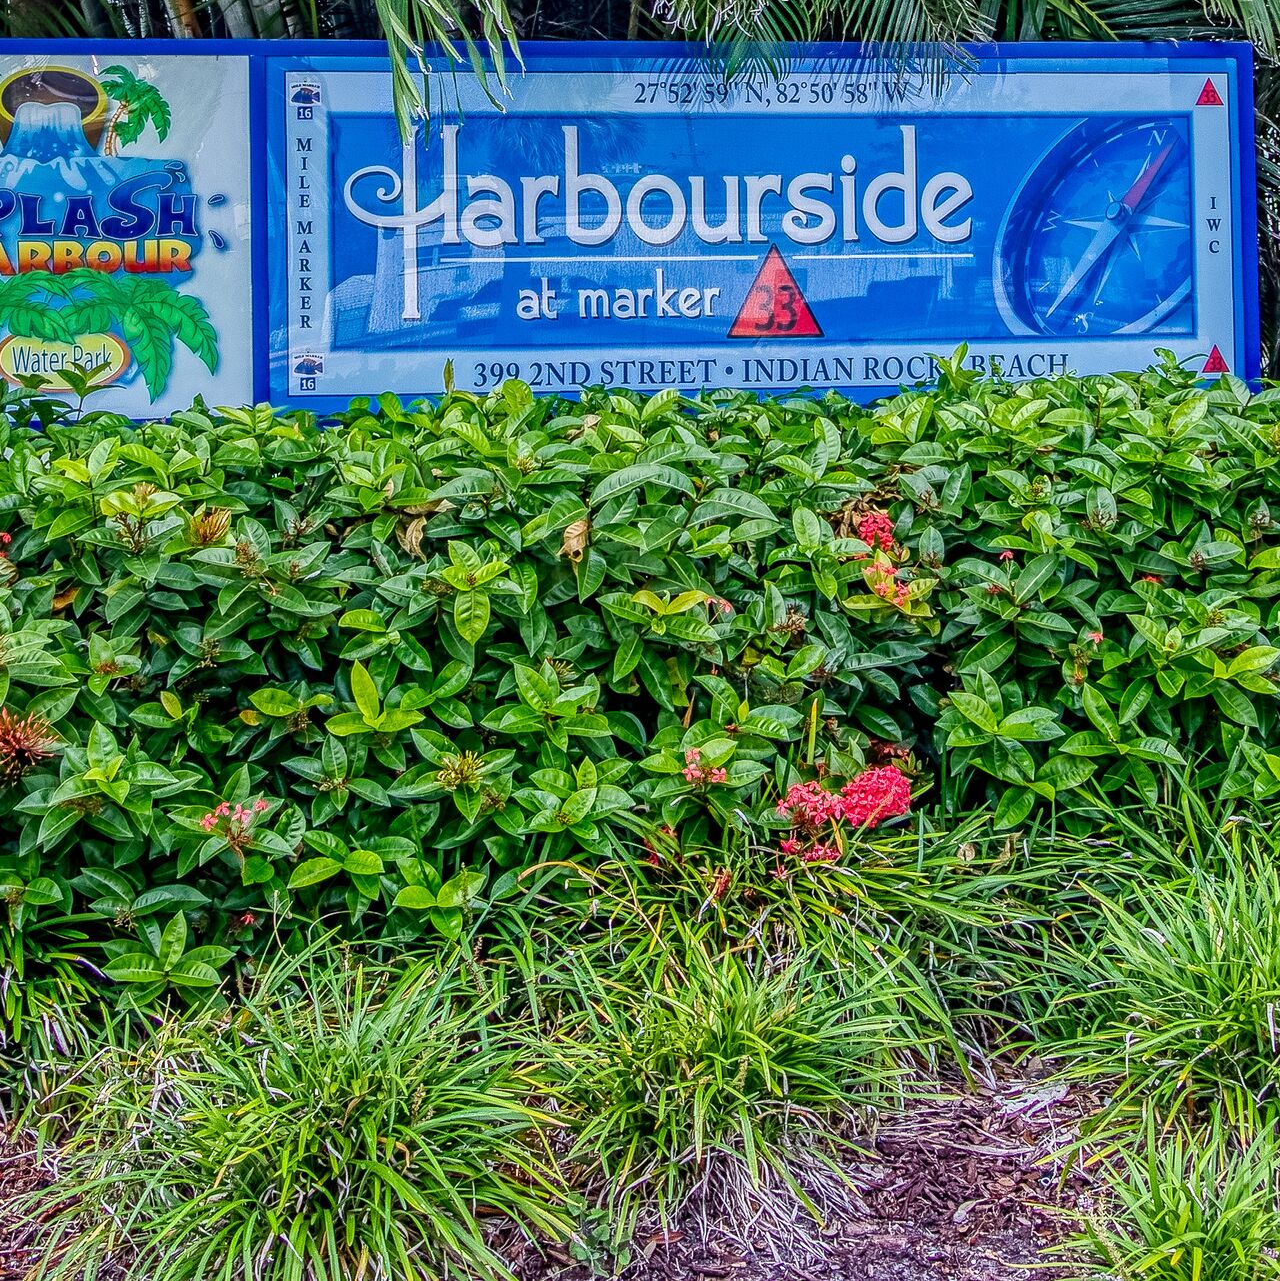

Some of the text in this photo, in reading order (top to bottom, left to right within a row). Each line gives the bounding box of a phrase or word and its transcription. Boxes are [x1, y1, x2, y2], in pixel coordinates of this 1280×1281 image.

[1203, 89, 1216, 103] 33
[299, 109, 312, 119] 16
[296, 138, 313, 329] MILE MARKER
[344, 123, 975, 320] Harbourside
[516, 269, 798, 331] at marker 33
[12, 343, 113, 373] Water Park
[473, 353, 1068, 387] 399 2ND STREET INDIAN ROCK BEACH
[302, 379, 314, 389] 16
